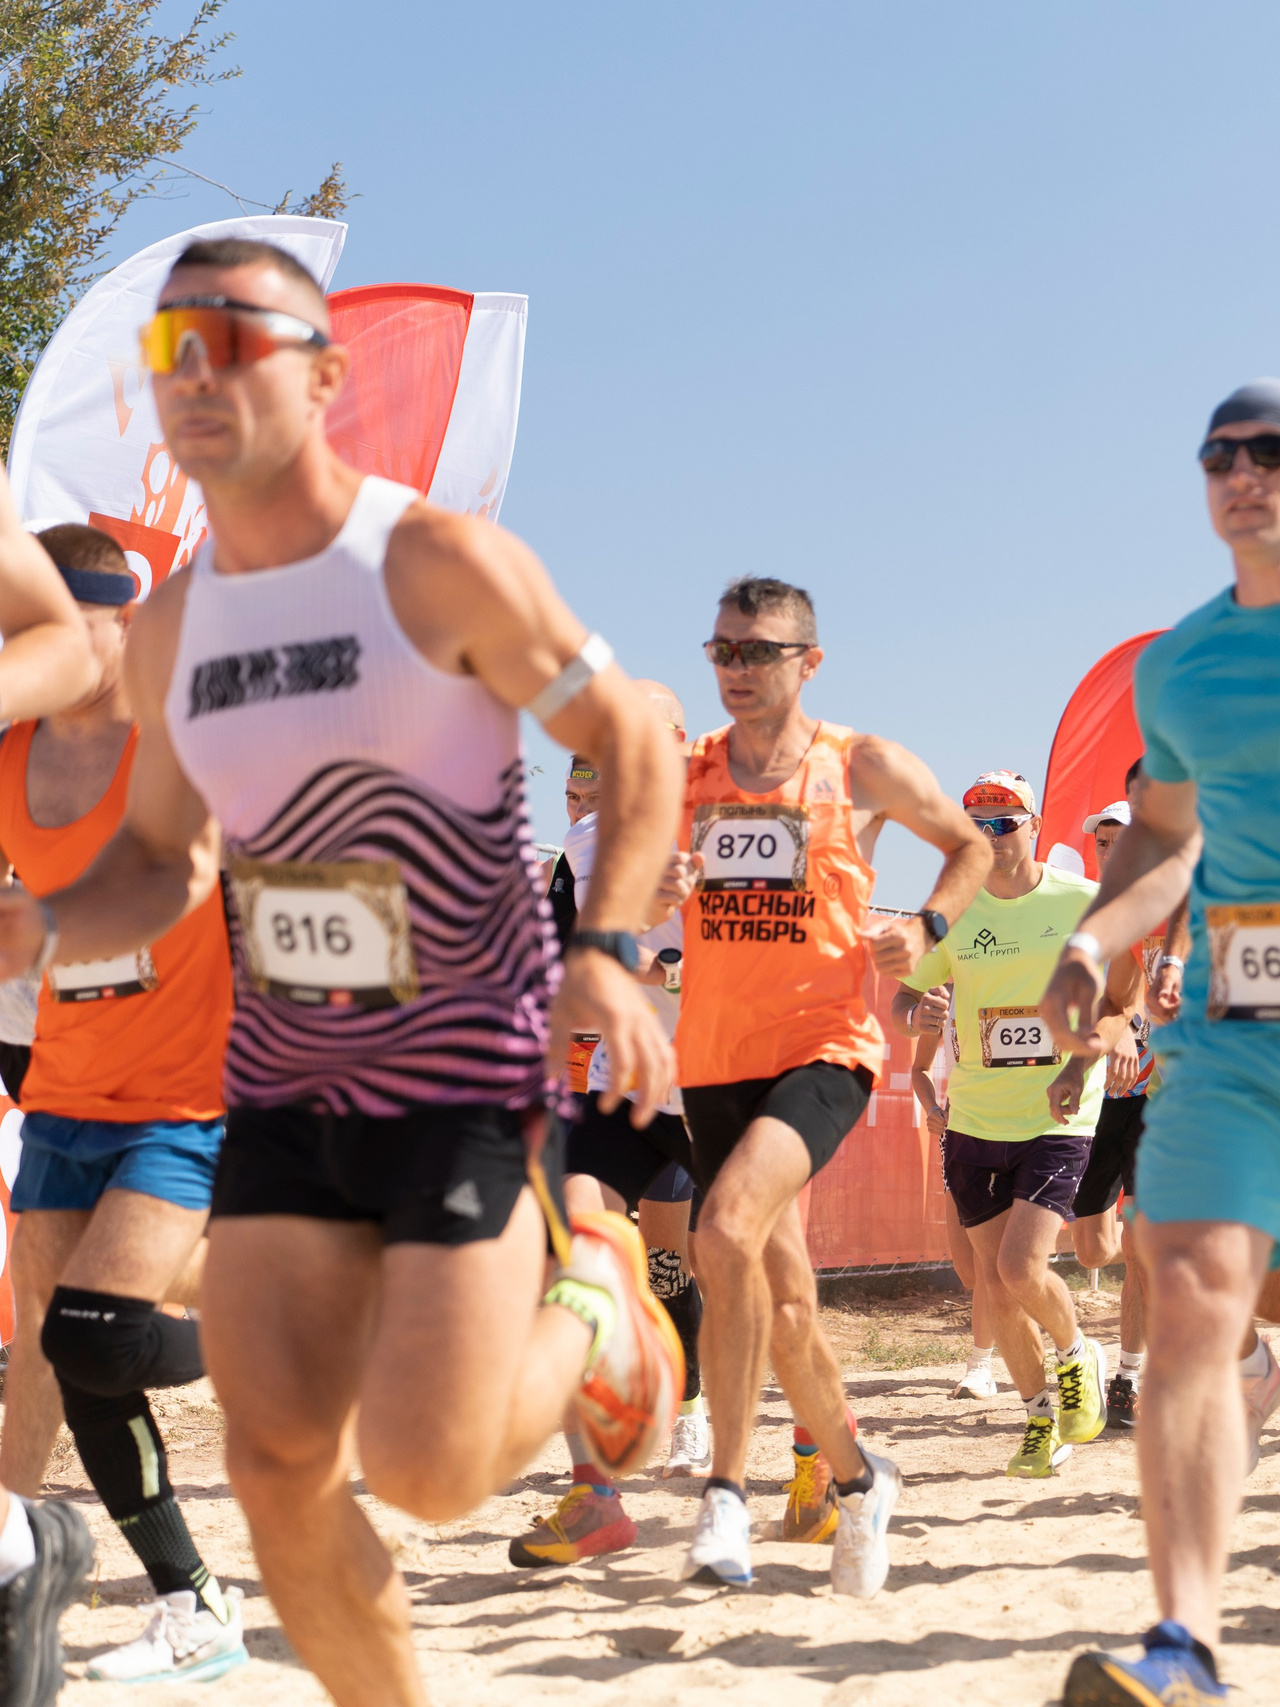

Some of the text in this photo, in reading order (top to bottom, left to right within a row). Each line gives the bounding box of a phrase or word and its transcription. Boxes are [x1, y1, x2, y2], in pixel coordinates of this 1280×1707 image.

[719, 806, 766, 816] ПОЛЫНЬ
[717, 834, 776, 859] 870
[699, 890, 815, 918] КРАСНЫЙ
[272, 912, 352, 955] 816
[701, 919, 806, 943] ОКТЯБРЬ
[957, 947, 1020, 961] МАКС ГРУПП
[1000, 1027, 1041, 1045] 623
